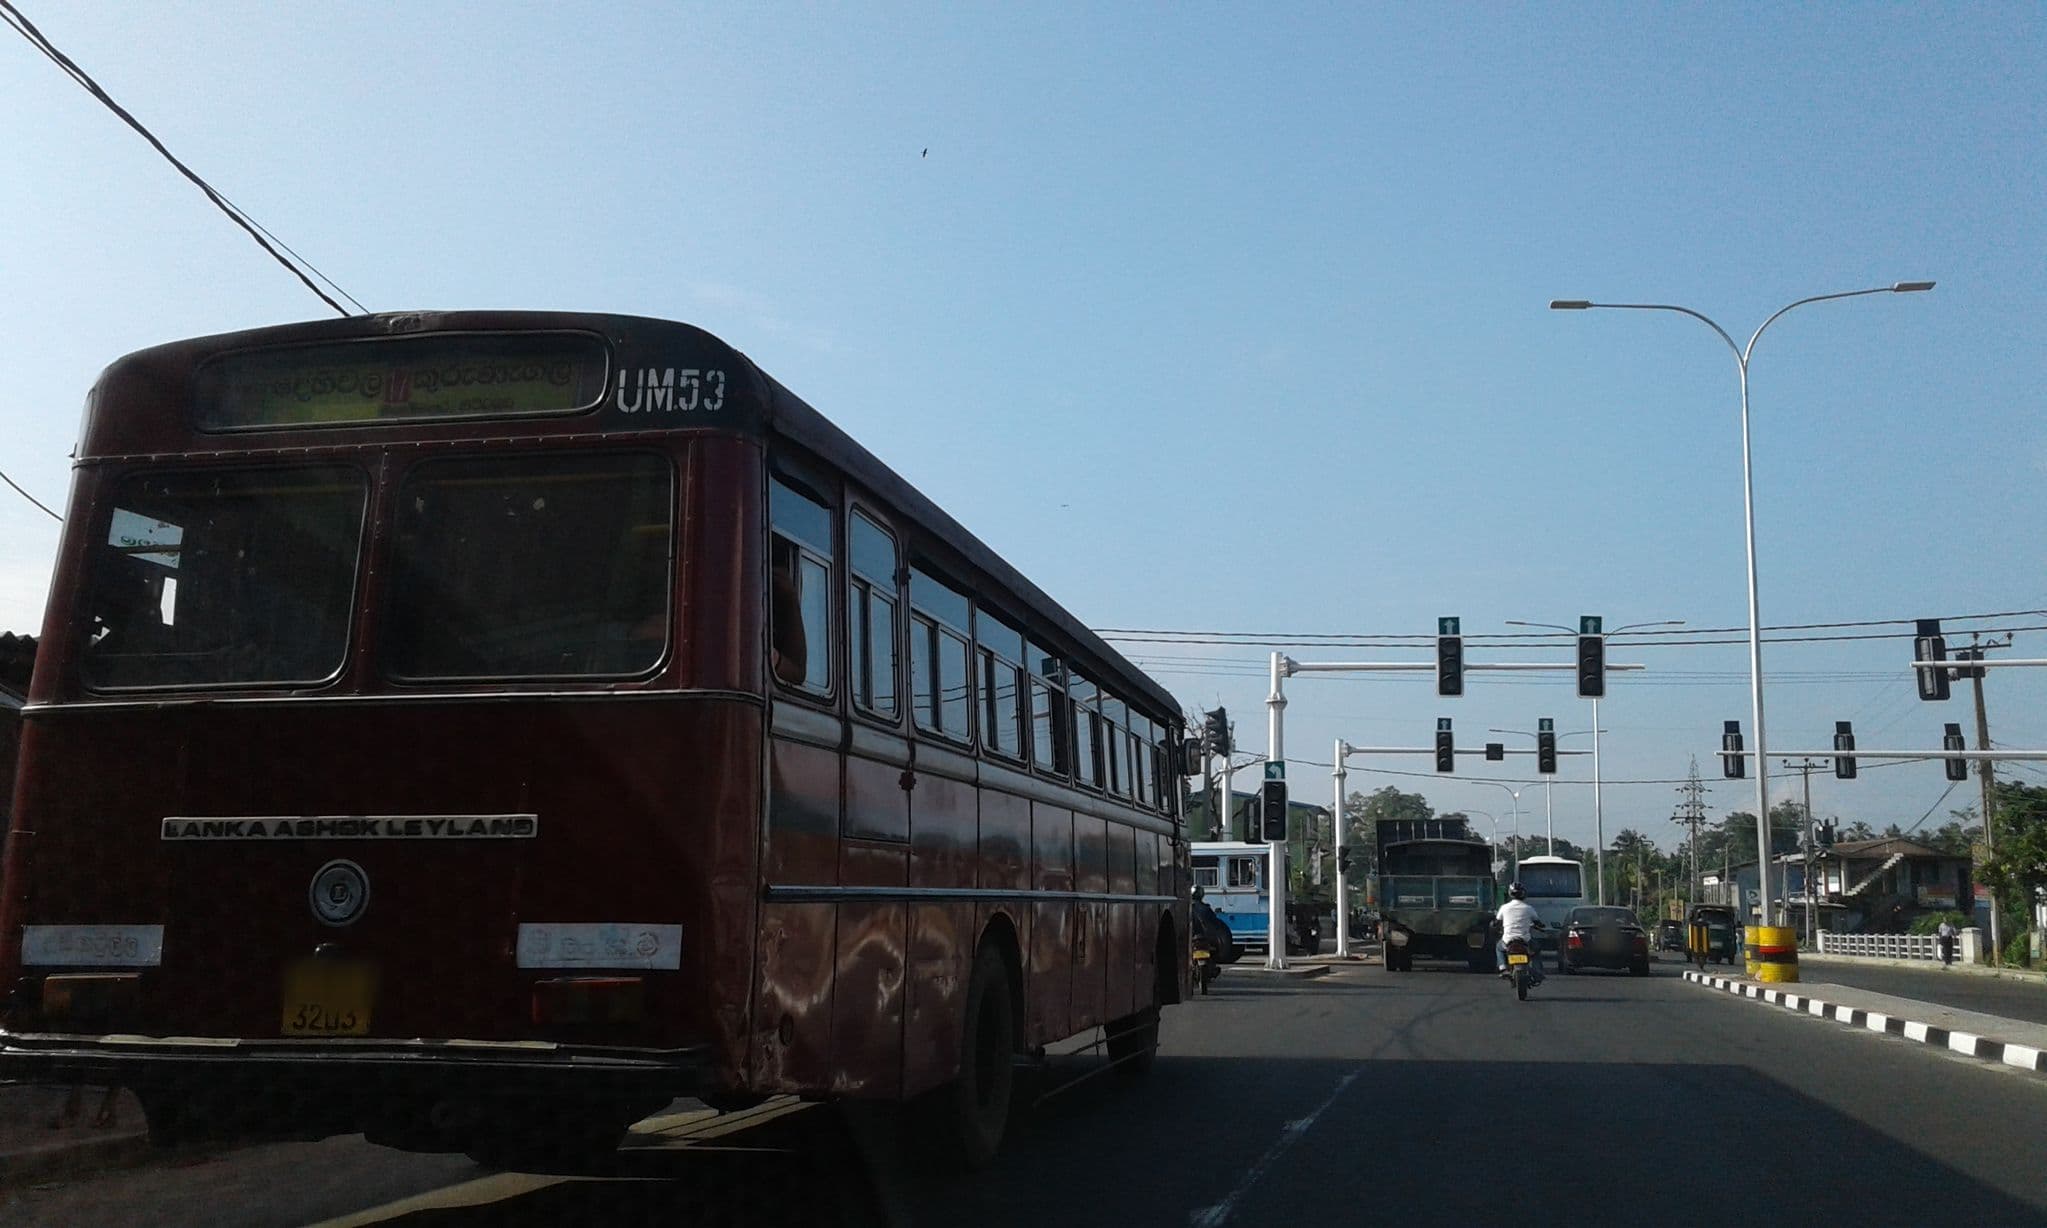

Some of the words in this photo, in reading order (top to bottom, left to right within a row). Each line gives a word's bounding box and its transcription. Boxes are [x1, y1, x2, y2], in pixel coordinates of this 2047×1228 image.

[165, 819, 267, 838] LANKA
[273, 818, 379, 837] ASHOK
[387, 817, 535, 837] LEYLAND
